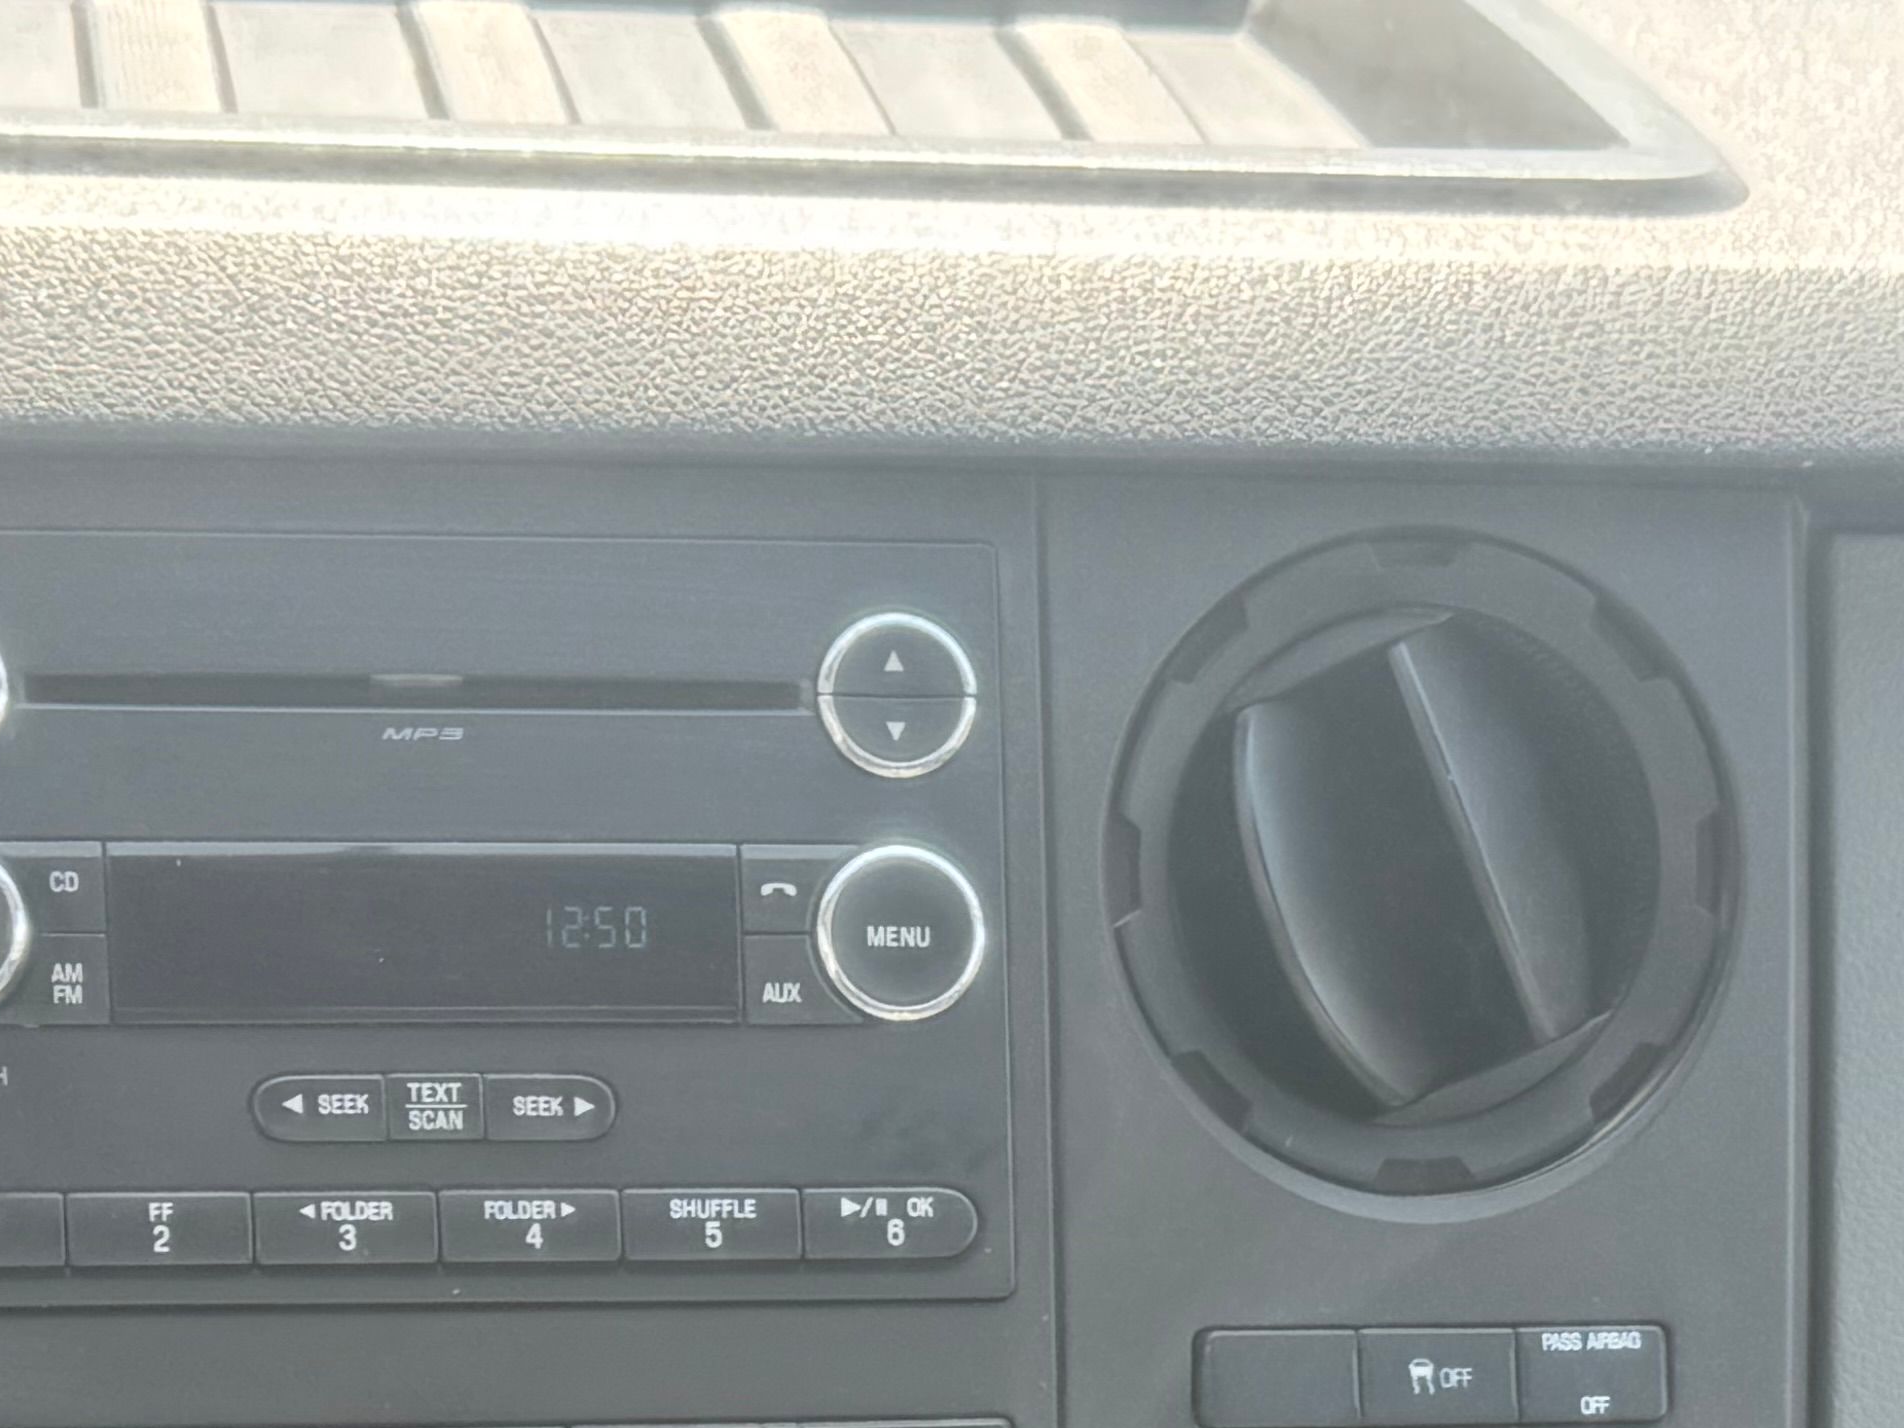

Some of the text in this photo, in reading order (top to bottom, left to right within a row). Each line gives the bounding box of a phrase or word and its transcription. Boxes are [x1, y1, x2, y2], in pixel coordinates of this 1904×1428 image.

[380, 726, 465, 742] MP3
[49, 870, 80, 893] CD
[545, 905, 648, 949] 12:50
[866, 925, 932, 948] MENU
[51, 962, 84, 983] AM
[52, 984, 84, 1006] FM
[762, 982, 802, 1004] AUX
[406, 1082, 463, 1103] TEXT
[317, 1093, 370, 1115] SEEK
[512, 1095, 564, 1117] SEEK
[407, 1109, 464, 1131] SCAN
[148, 1202, 175, 1222] FF
[320, 1200, 394, 1221] FOLDER
[483, 1199, 556, 1220] FOLDER
[669, 1198, 757, 1219] SHUFFLE
[906, 1196, 935, 1217] OK
[152, 1224, 171, 1253] 2
[339, 1223, 358, 1252] 3
[525, 1222, 544, 1249] 4
[705, 1220, 724, 1249] 5
[887, 1218, 906, 1247] 6
[1541, 1331, 1583, 1352] PASS
[1439, 1367, 1473, 1388] OFF
[1580, 1395, 1612, 1416] OFF
